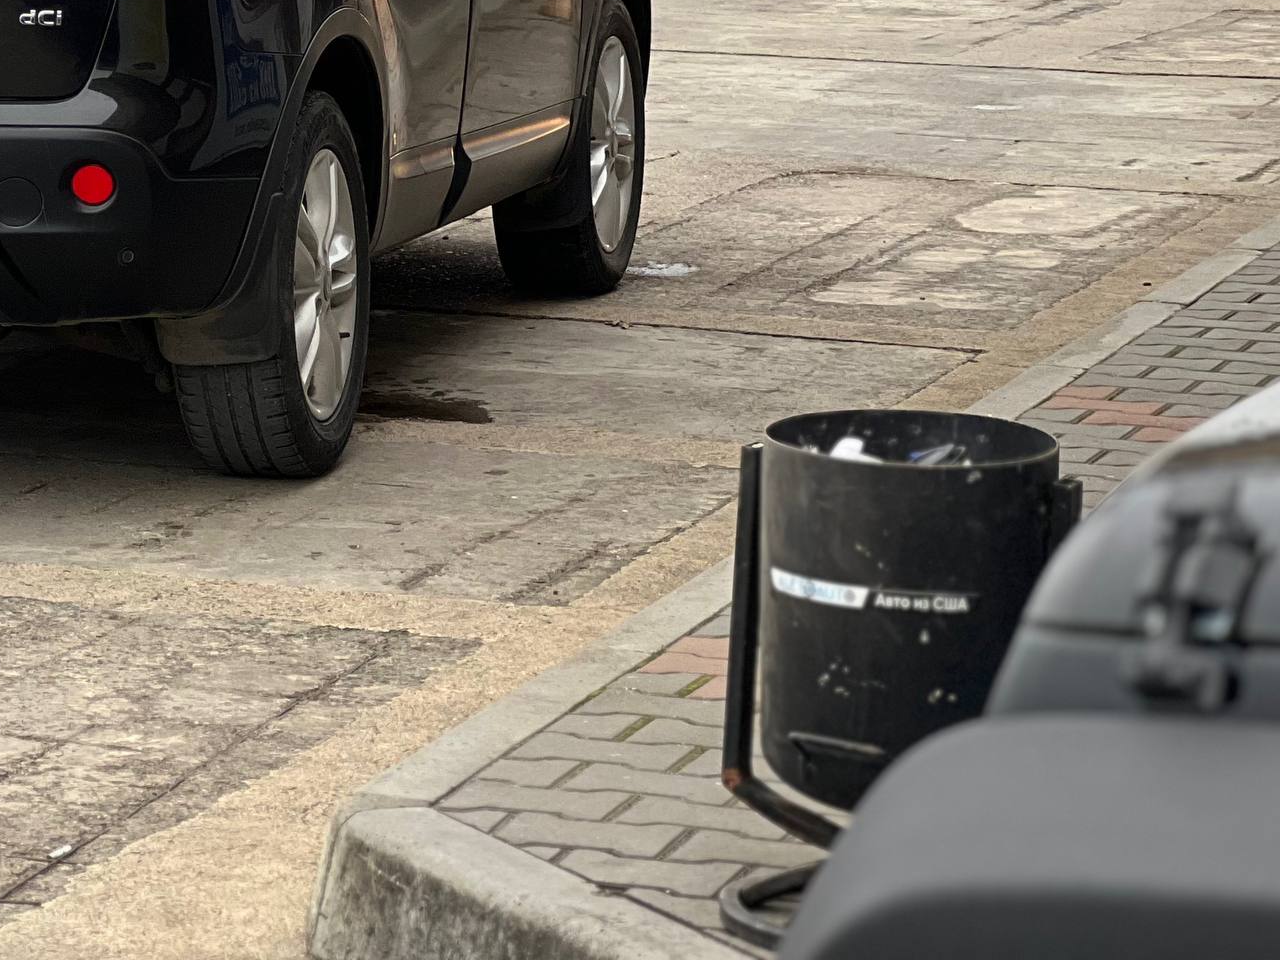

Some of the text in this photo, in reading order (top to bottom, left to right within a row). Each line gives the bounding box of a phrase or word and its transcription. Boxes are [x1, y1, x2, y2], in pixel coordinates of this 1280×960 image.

[19, 9, 63, 26] dCi
[874, 594, 969, 611] Авто из США
